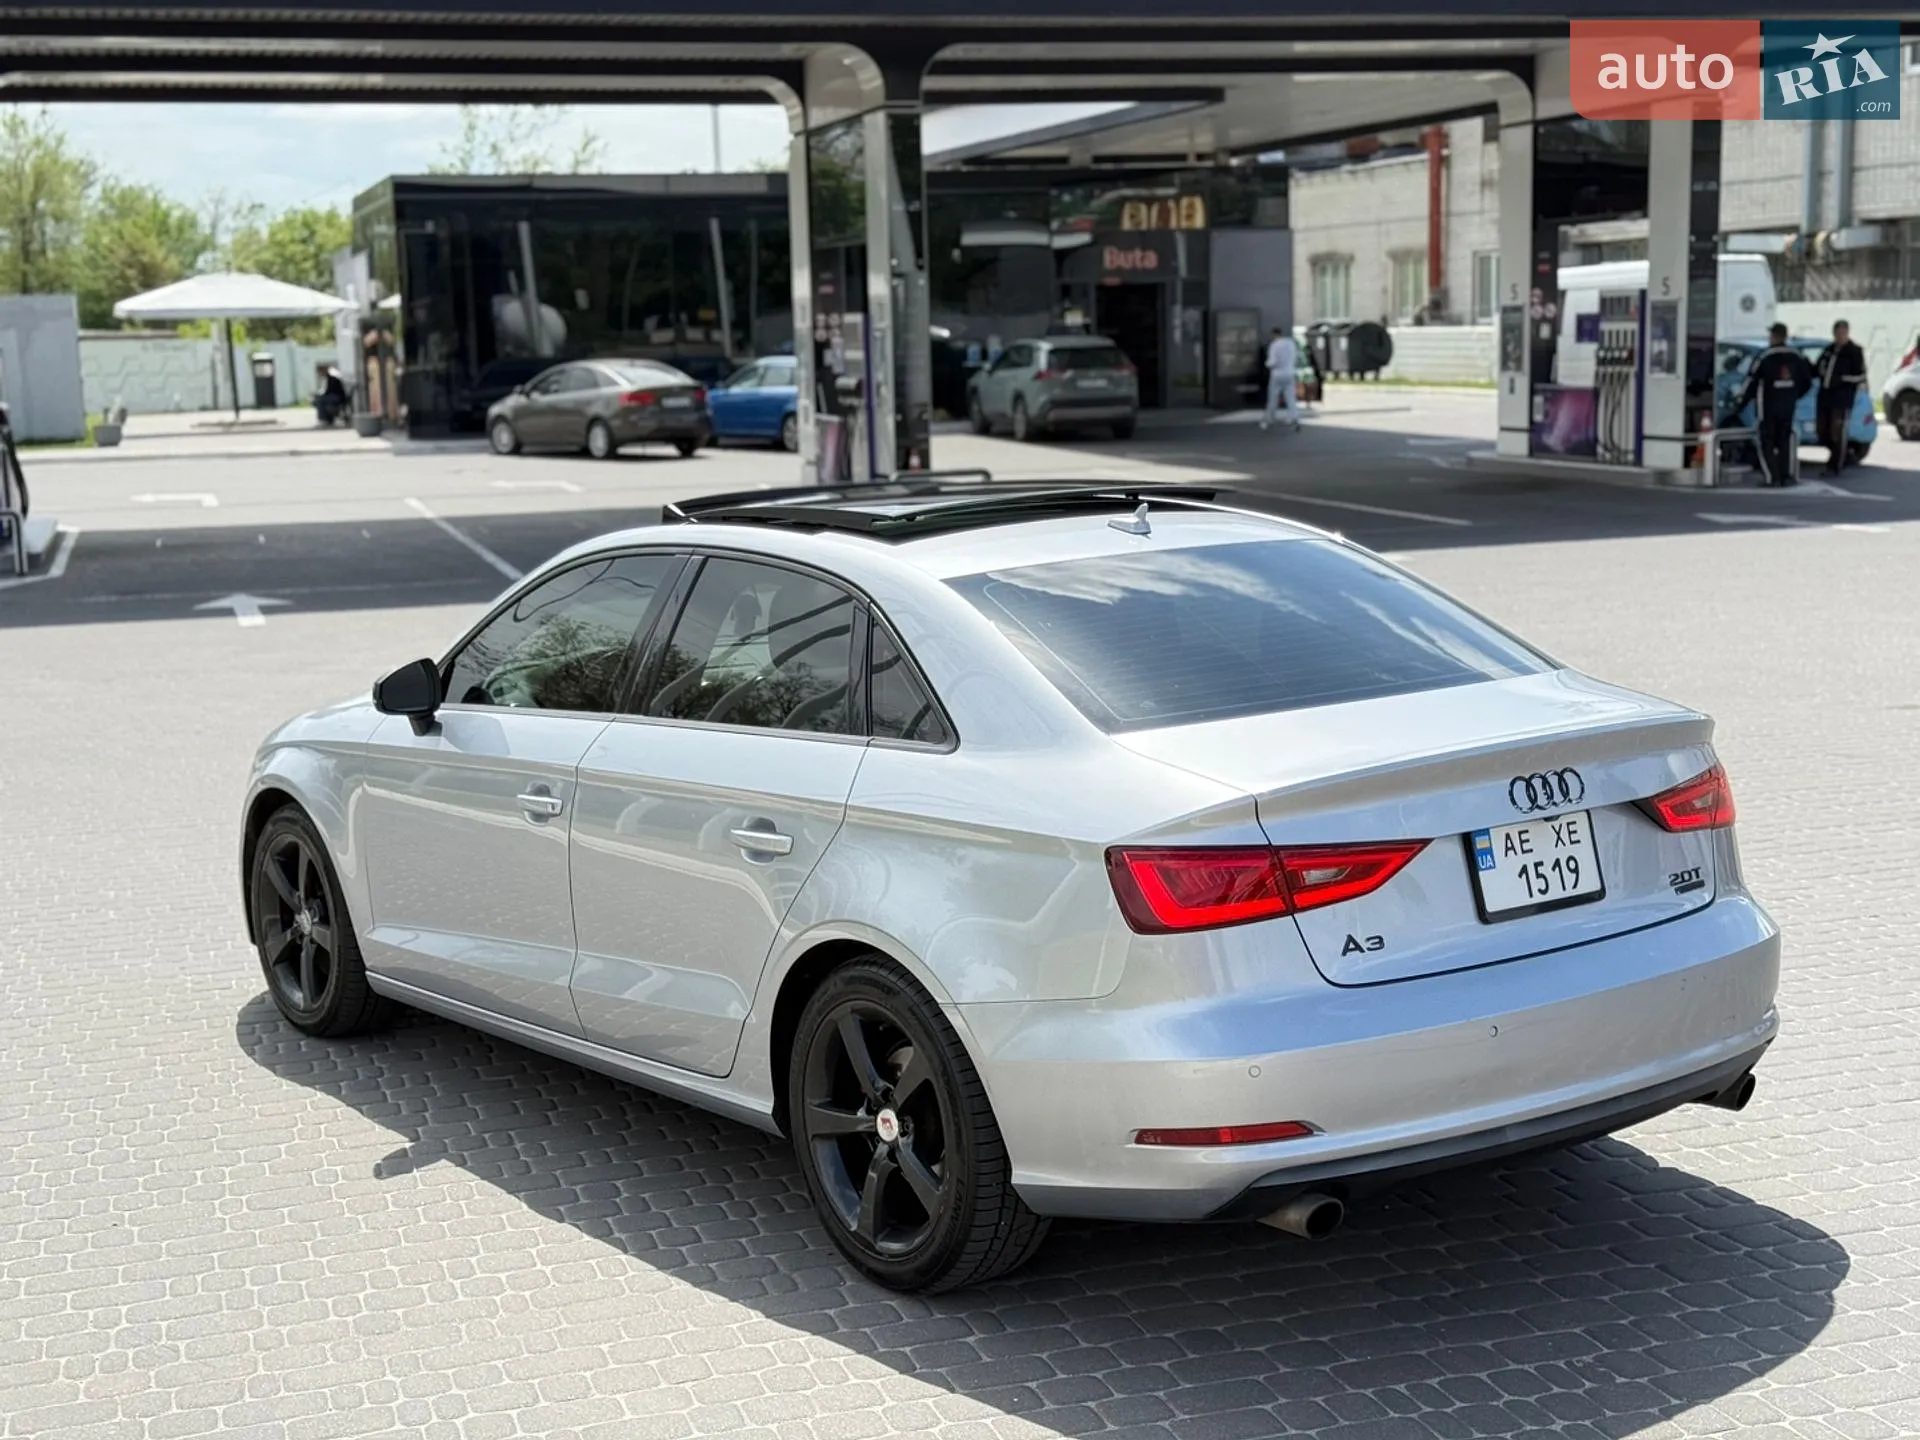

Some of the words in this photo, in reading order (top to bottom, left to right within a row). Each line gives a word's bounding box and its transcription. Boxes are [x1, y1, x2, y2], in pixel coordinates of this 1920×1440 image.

[1103, 246, 1158, 270] Buta
[1503, 830, 1533, 858] AE
[1551, 820, 1581, 849] XE
[1479, 856, 1495, 869] UA
[1517, 855, 1580, 898] 1519
[1341, 933, 1385, 957] A3
